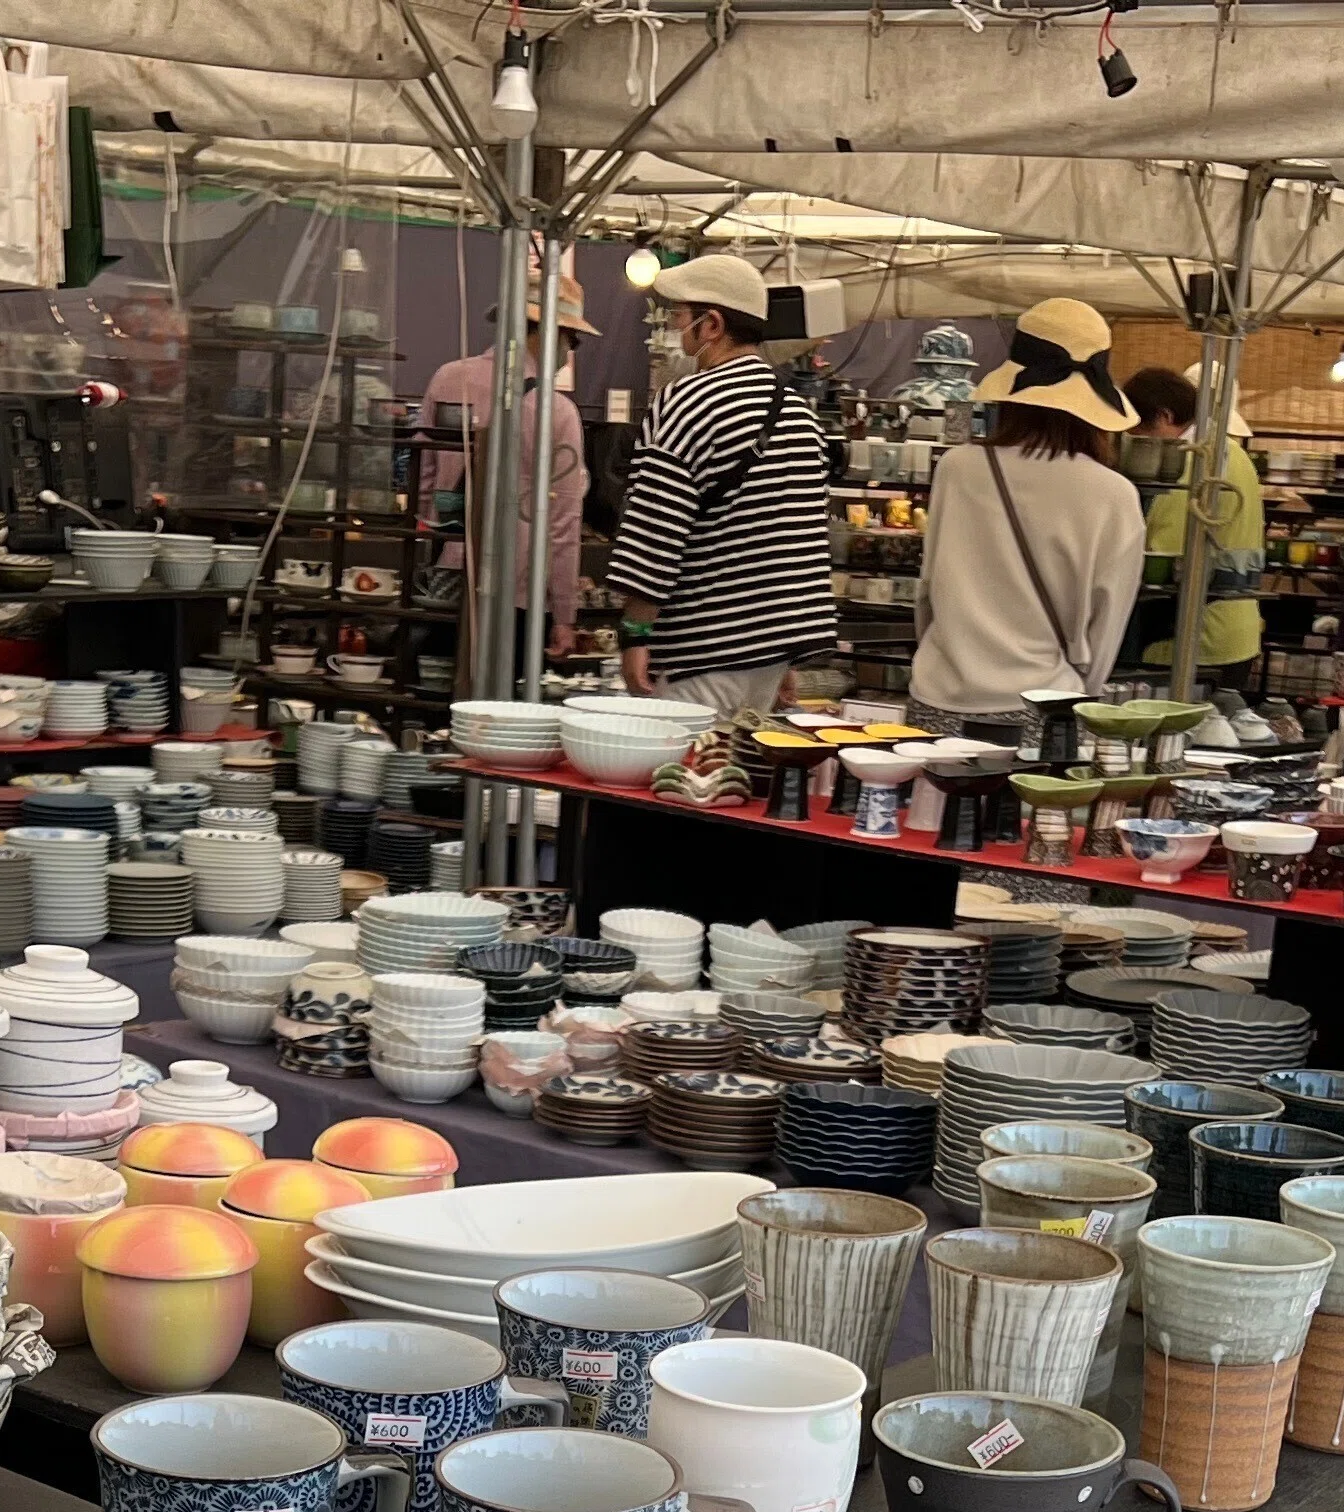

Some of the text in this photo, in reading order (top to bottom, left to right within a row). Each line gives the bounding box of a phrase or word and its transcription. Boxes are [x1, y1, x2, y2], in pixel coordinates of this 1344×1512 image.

[565, 1360, 601, 1374] ¥600
[370, 1424, 409, 1439] ¥600
[978, 1434, 1014, 1460] ¥600-
